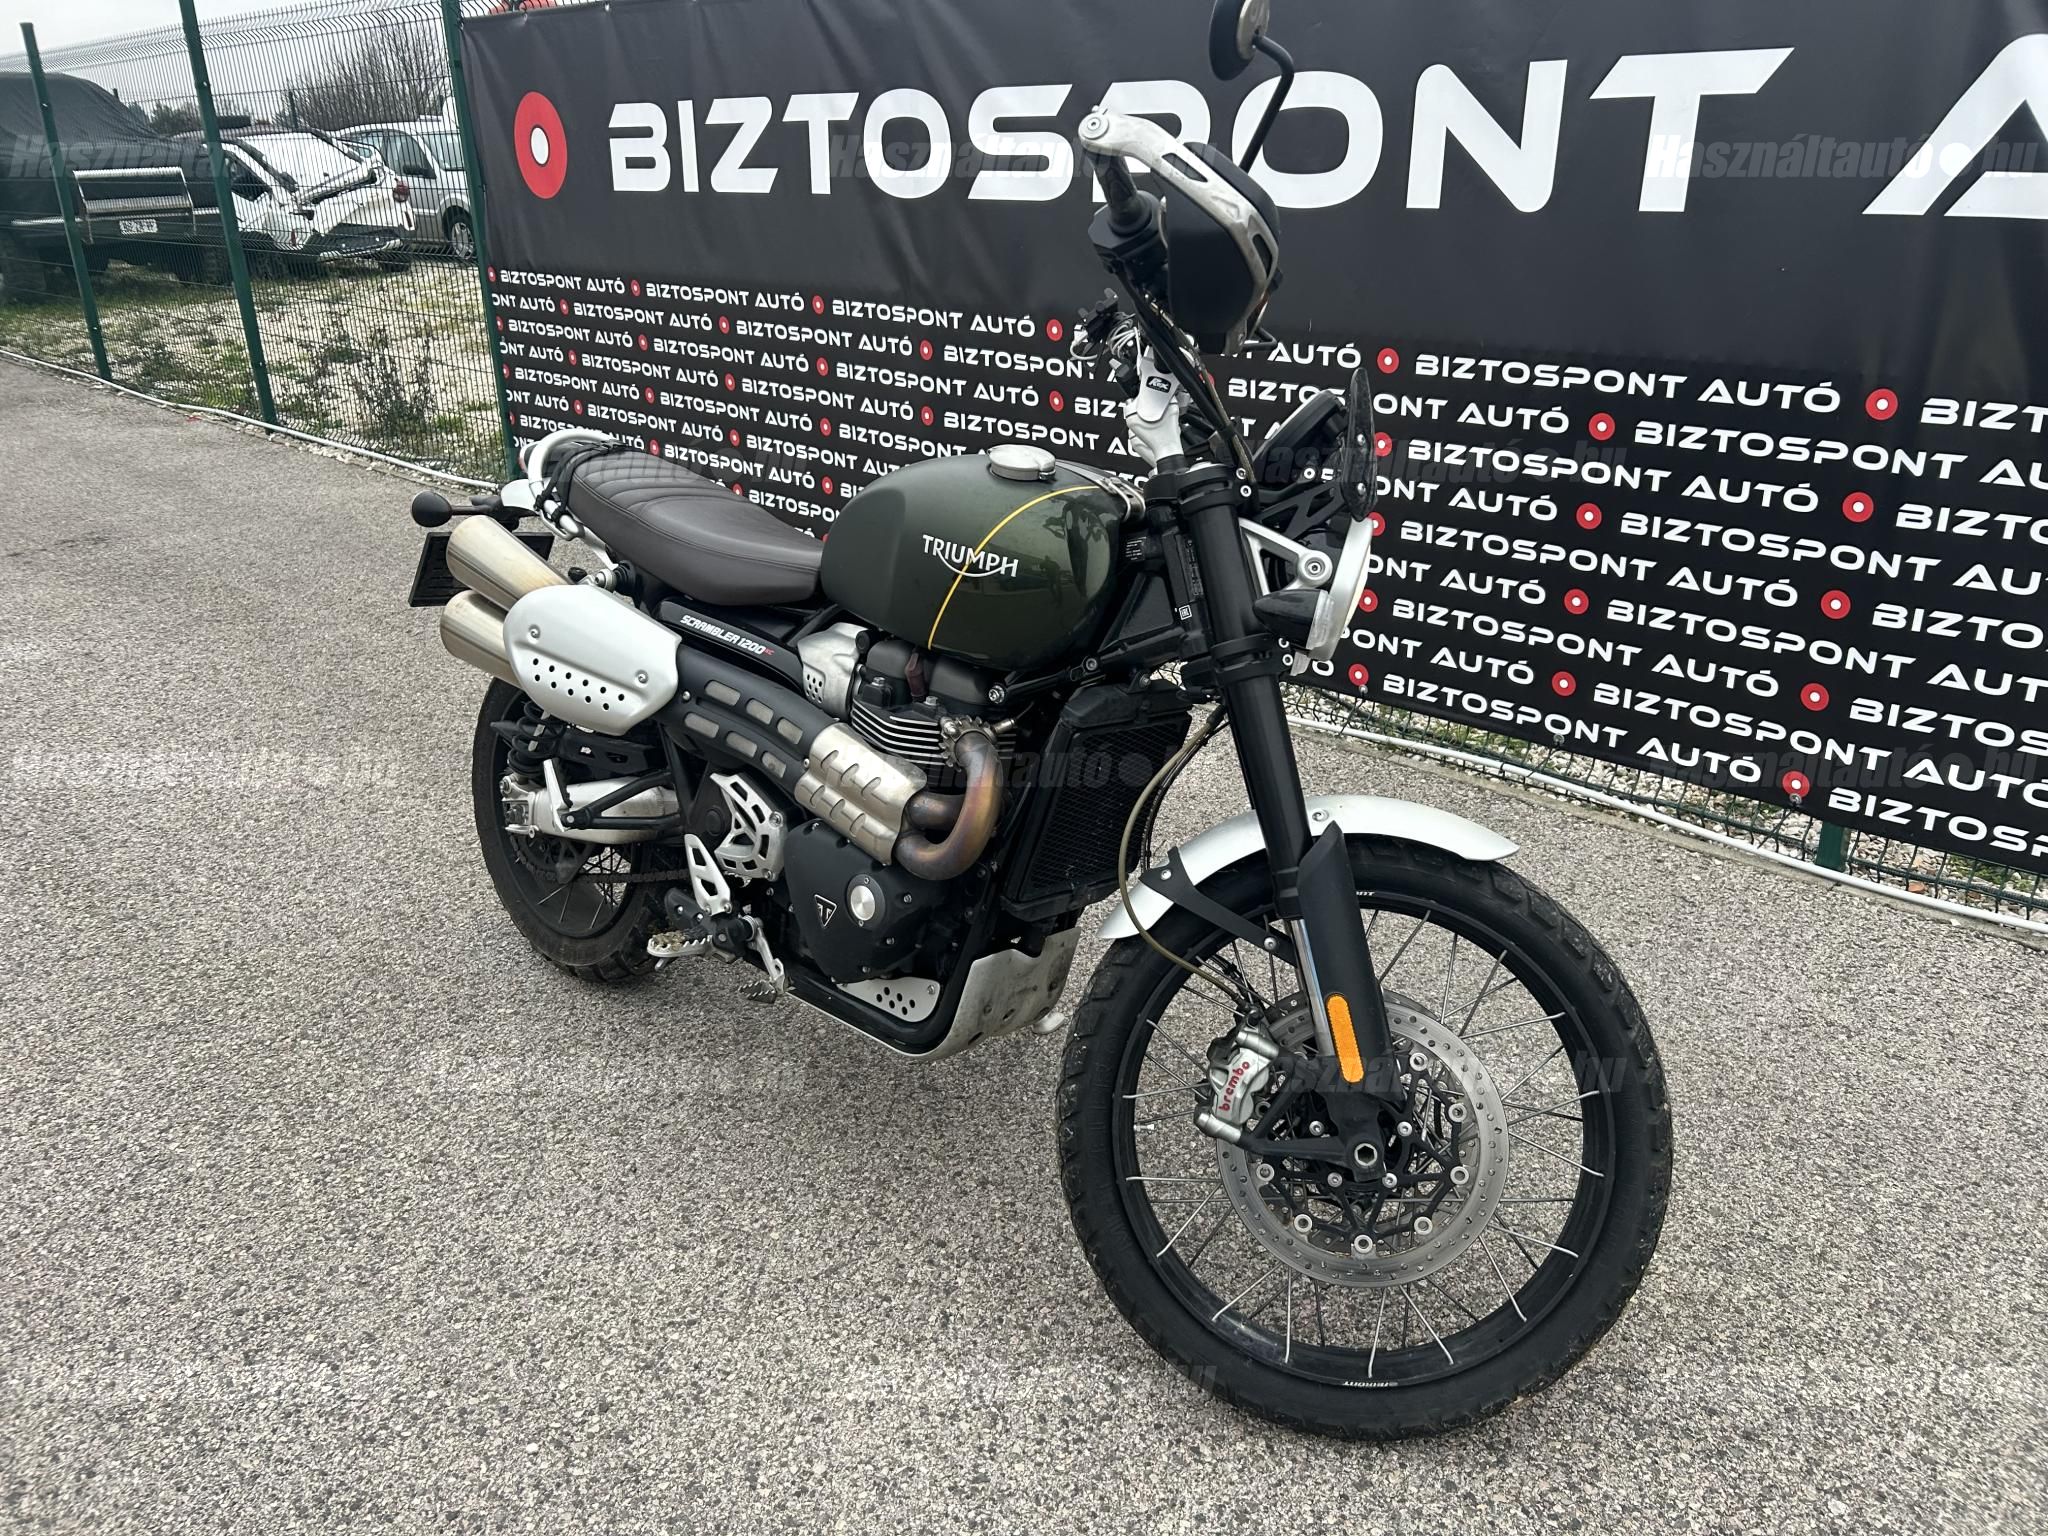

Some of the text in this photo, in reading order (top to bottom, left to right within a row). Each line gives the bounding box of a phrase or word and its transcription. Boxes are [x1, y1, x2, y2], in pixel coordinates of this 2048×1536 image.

[501, 270, 581, 289] BIZTOSPONT
[587, 276, 625, 294] AUTÓ
[646, 283, 749, 305] BIZTOSPONT
[755, 291, 804, 311] AUTÓ
[833, 299, 964, 329] BIZTOSPONT
[970, 314, 1035, 337] AUTÓ
[1267, 342, 1361, 368] AUTÓ
[1416, 354, 1687, 398] BIZTOSPONT
[1698, 378, 1840, 412] AUTÓ
[509, 319, 590, 341] BIZTOSPONT
[595, 331, 633, 347] AUTÓ
[654, 338, 754, 364] BIZTOSPONT
[761, 352, 809, 372] AUTÓ
[837, 363, 967, 396] BIZTOSPONT
[974, 383, 1038, 406] AUTÓ
[1408, 440, 1671, 491] BIZTOSPONT
[1681, 476, 1818, 512] AUTÓ
[520, 297, 555, 312] AUTÓ
[574, 303, 664, 325] BIZTOSPONT
[670, 313, 712, 330] AUTÓ
[737, 320, 852, 347] BIZTOSPONT
[859, 334, 912, 356] AUTÓ
[1457, 403, 1569, 433] AUTÓ
[1635, 421, 1968, 479] BIZTOSPONT
[515, 367, 598, 392] BIZTOSPONT
[602, 382, 640, 400] AUTÓ
[660, 392, 760, 422] BIZTOSPONT
[765, 410, 812, 431] AUTÓ
[1401, 521, 1656, 580] BIZTOSPONT
[1667, 567, 1797, 607] AUTÓ
[529, 346, 564, 362] AUTÓ
[582, 354, 671, 379] BIZTOSPONT
[676, 368, 718, 387] AUTÓ
[742, 378, 855, 410] BIZTOSPONT
[860, 397, 913, 420] AUTÓ
[944, 412, 1099, 450] BIZTOSPONT
[1448, 488, 1557, 520] AUTÓ
[1621, 513, 1941, 581] BIZTOSPONT
[534, 394, 569, 411] AUTÓ
[588, 404, 677, 432] BIZTOSPONT
[681, 422, 723, 442] AUTÓ
[747, 434, 858, 470] BIZTOSPONT
[1440, 569, 1545, 604] AUTÓ
[1607, 600, 1916, 678] BIZTOSPONT
[664, 444, 764, 477] BIZTOSPONT
[768, 467, 815, 489] AUTÓ
[1393, 599, 1642, 666] BIZTOSPONT
[1652, 654, 1778, 697] AUTÓ
[679, 614, 739, 645] SCRAMBLER
[738, 636, 766, 656] 1200
[922, 534, 1019, 578] TRIUMPH
[1384, 674, 1628, 747] BIZTOSPONT
[1637, 738, 1761, 782] AUTÓ
[1430, 647, 1533, 684] AUTÓ
[1594, 683, 1892, 770] BIZTOSPONT
[1216, 1060, 1250, 1112] brembo
